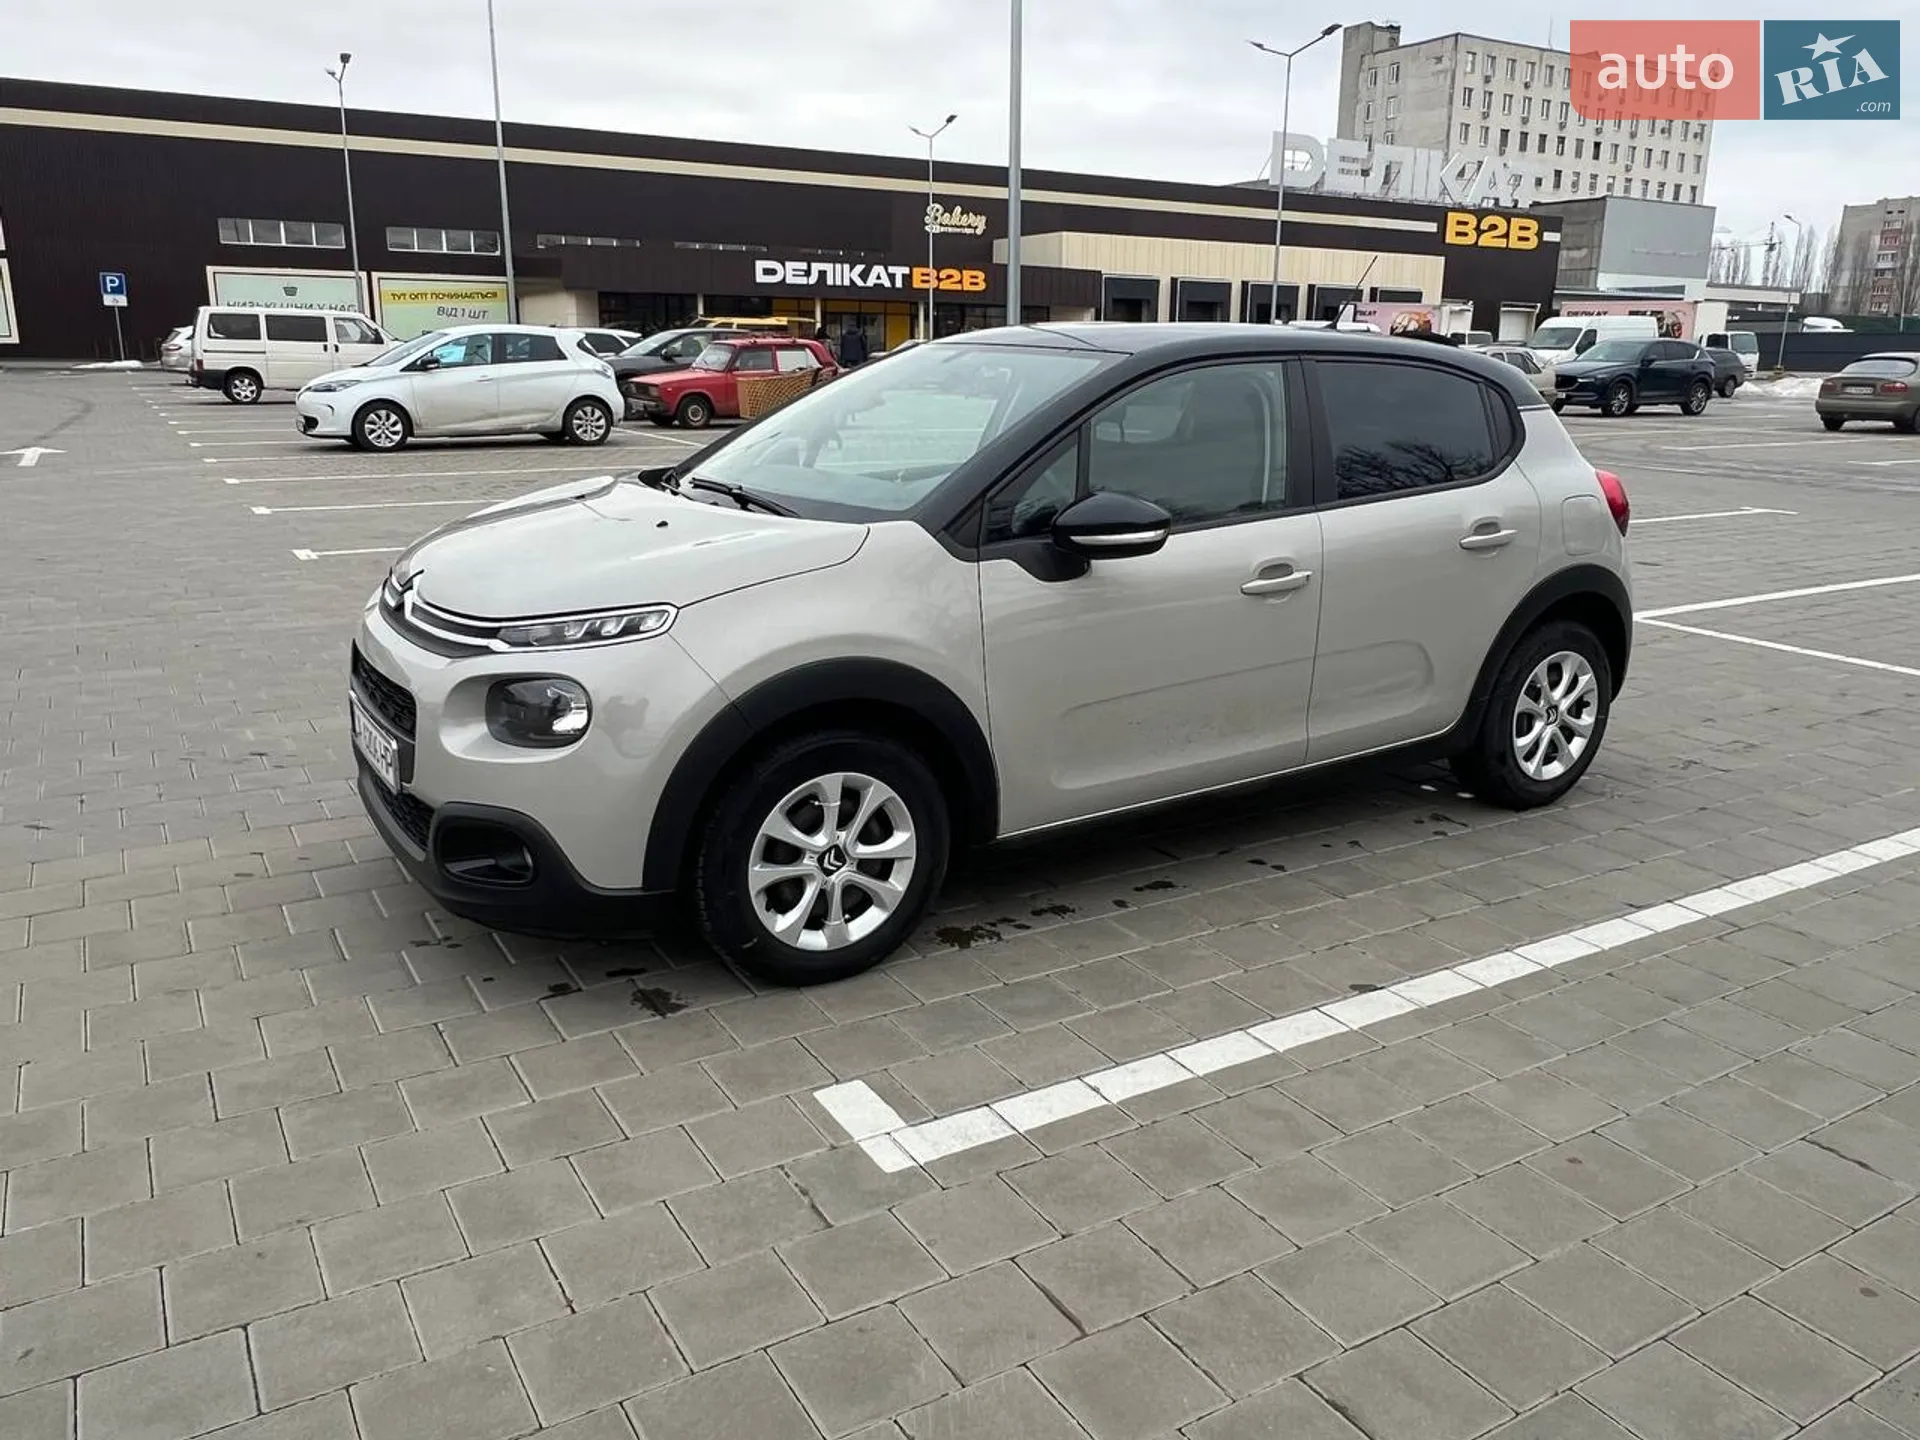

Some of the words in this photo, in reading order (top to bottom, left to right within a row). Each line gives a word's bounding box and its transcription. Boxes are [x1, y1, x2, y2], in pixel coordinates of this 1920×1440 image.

[924, 203, 987, 235] Bakery
[1445, 211, 1539, 250] B2B
[106, 276, 120, 292] P
[436, 305, 458, 318] ВІД
